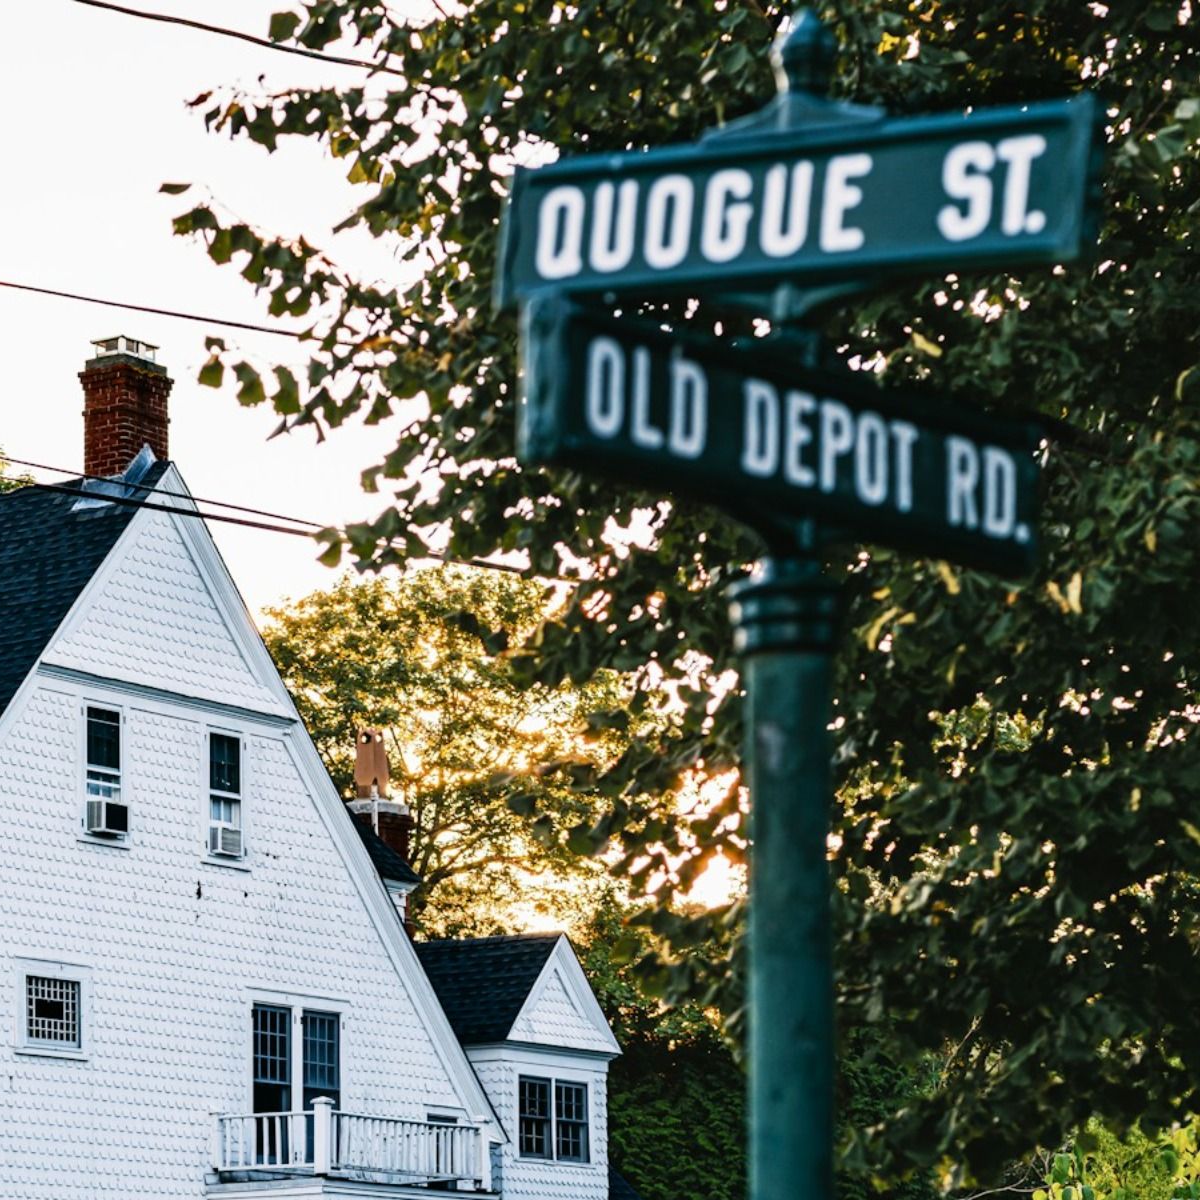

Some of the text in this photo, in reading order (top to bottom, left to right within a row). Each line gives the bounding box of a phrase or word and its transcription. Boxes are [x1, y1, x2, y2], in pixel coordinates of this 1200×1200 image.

[535, 134, 1047, 280] QUOGUE ST.
[586, 336, 1030, 542] OLD DEPOT RD.
